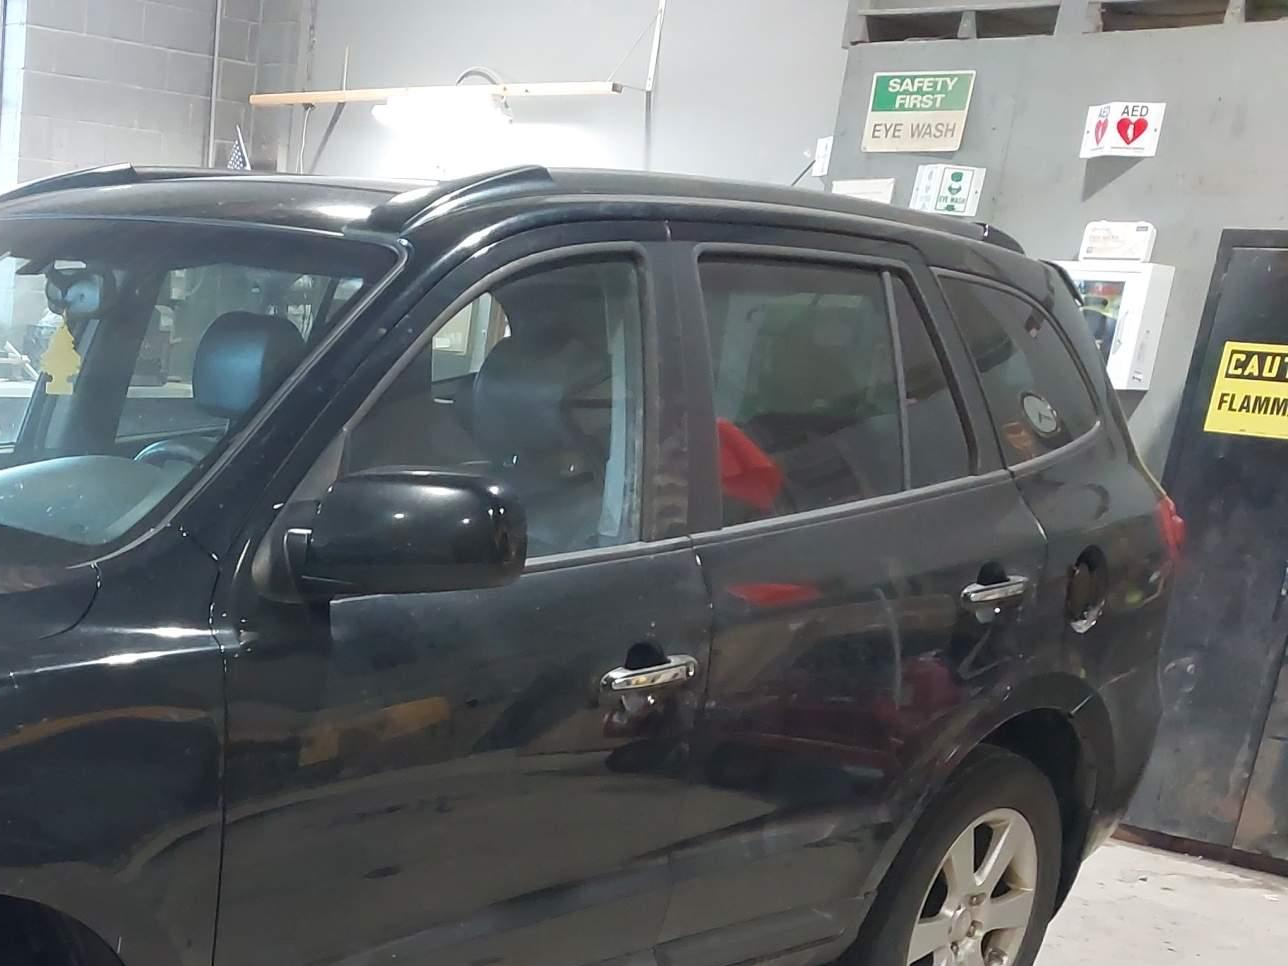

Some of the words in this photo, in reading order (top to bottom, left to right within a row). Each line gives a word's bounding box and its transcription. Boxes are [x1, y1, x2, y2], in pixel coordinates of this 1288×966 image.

[888, 77, 958, 92] SAFETY
[895, 94, 945, 108] FIRST
[1121, 105, 1149, 117] AED
[872, 123, 903, 138] EYE
[911, 122, 956, 138] WASH
[1228, 353, 1288, 379] CAU
